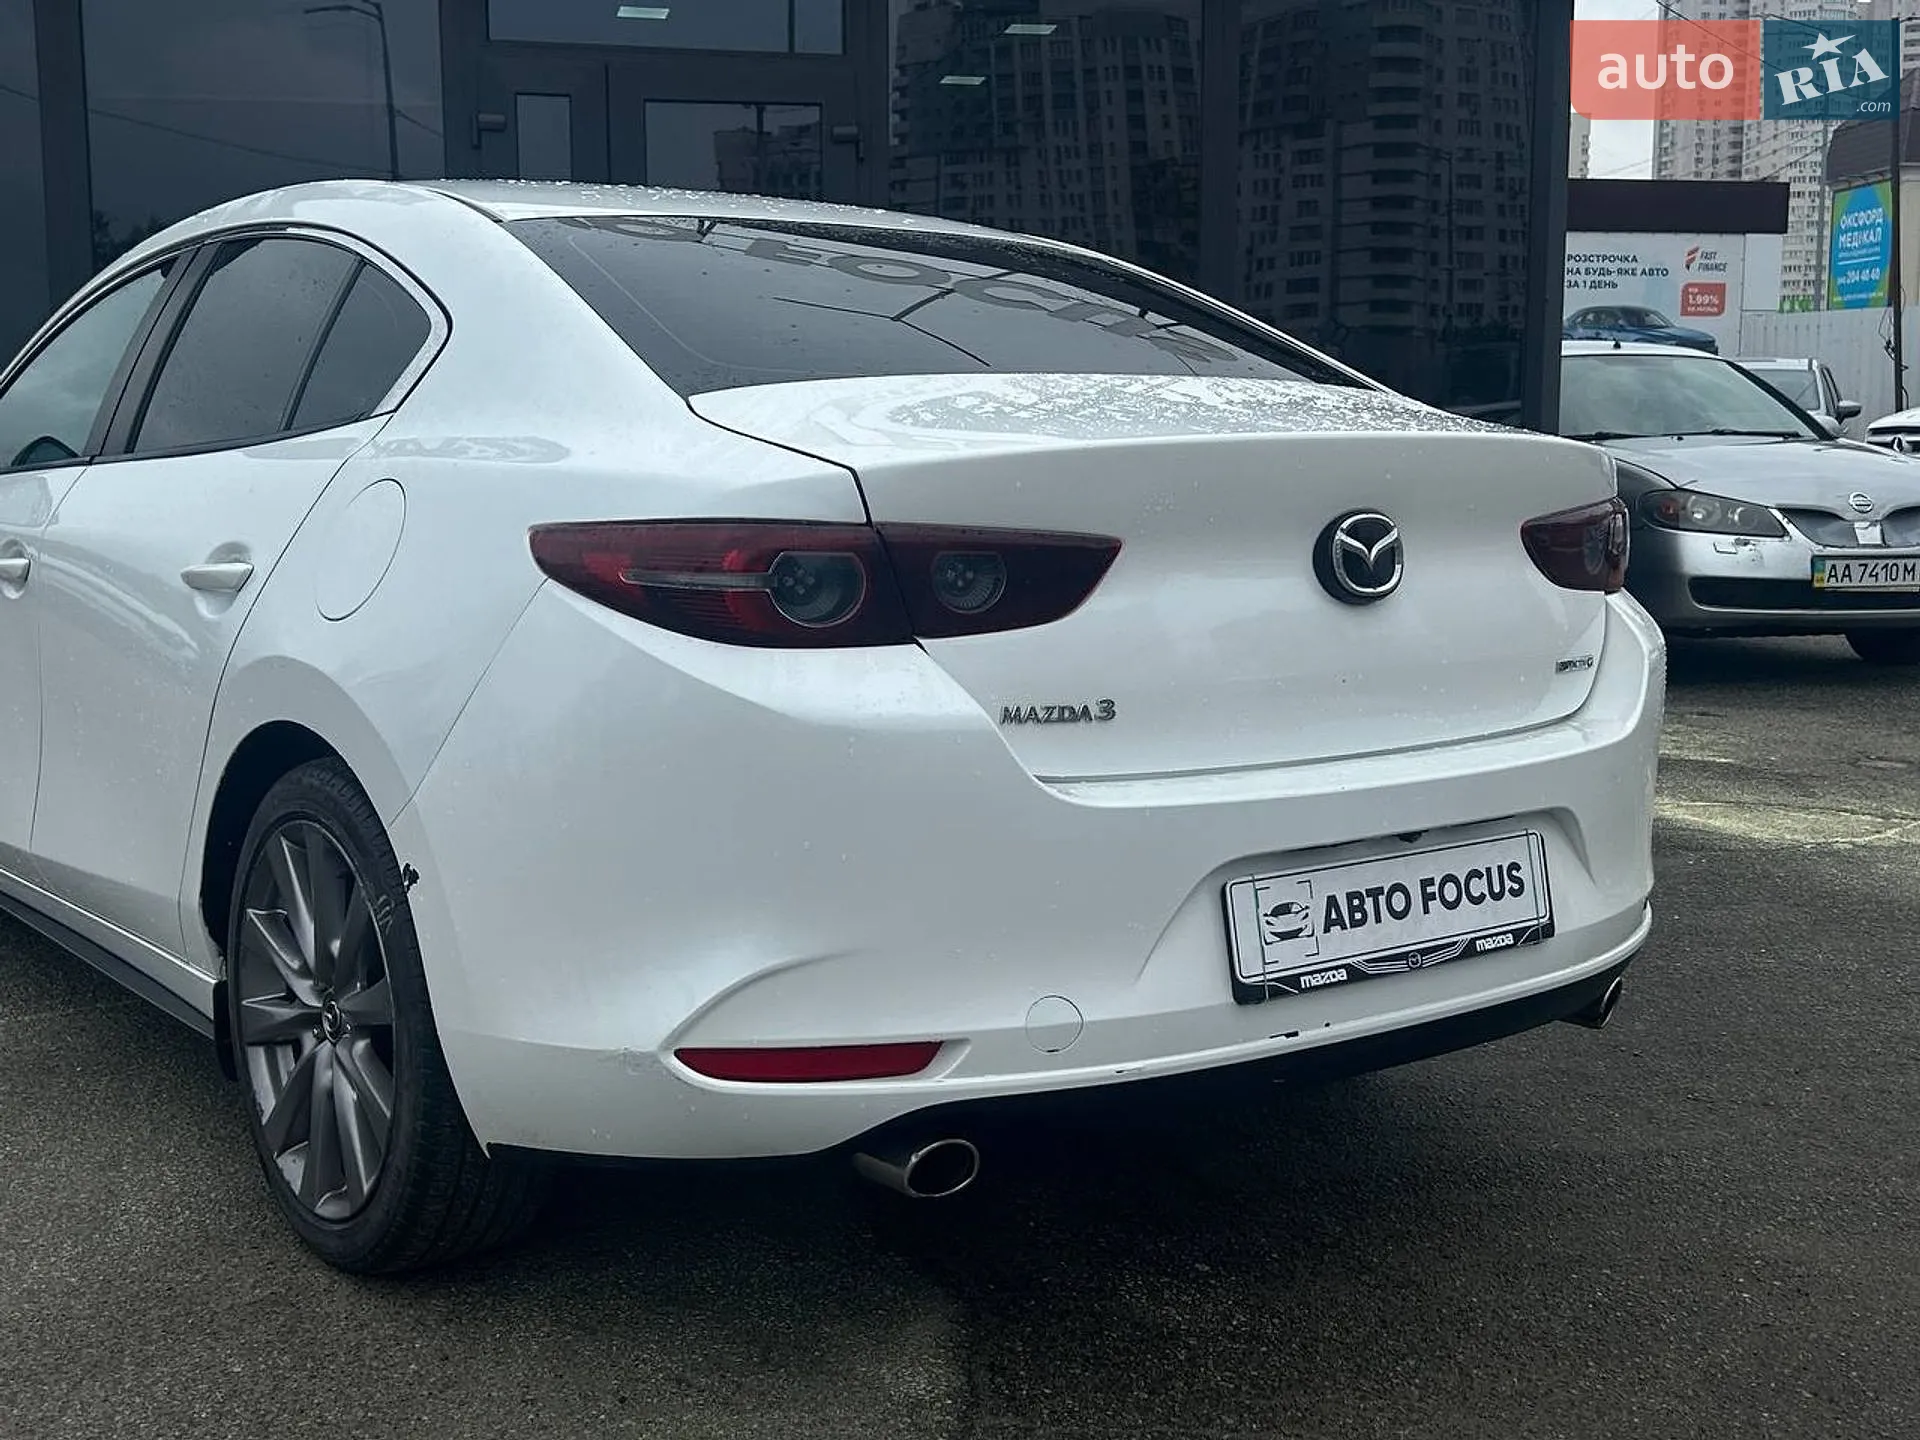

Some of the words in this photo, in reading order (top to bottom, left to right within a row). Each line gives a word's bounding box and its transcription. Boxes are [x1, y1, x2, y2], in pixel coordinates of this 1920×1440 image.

[1566, 253, 1639, 264] РОЗСТРОЧКА
[1566, 267, 1581, 277] НА
[1640, 267, 1669, 277] АВТО
[1566, 280, 1580, 289] ЗА
[1582, 280, 1587, 289] 1
[1588, 280, 1619, 290] ДЕНЬ
[1827, 564, 1852, 583] AA
[1858, 562, 1899, 582] 7410
[1419, 861, 1526, 914] FOCUS
[1301, 968, 1348, 989] mazda
[1476, 933, 1514, 953] mazda
